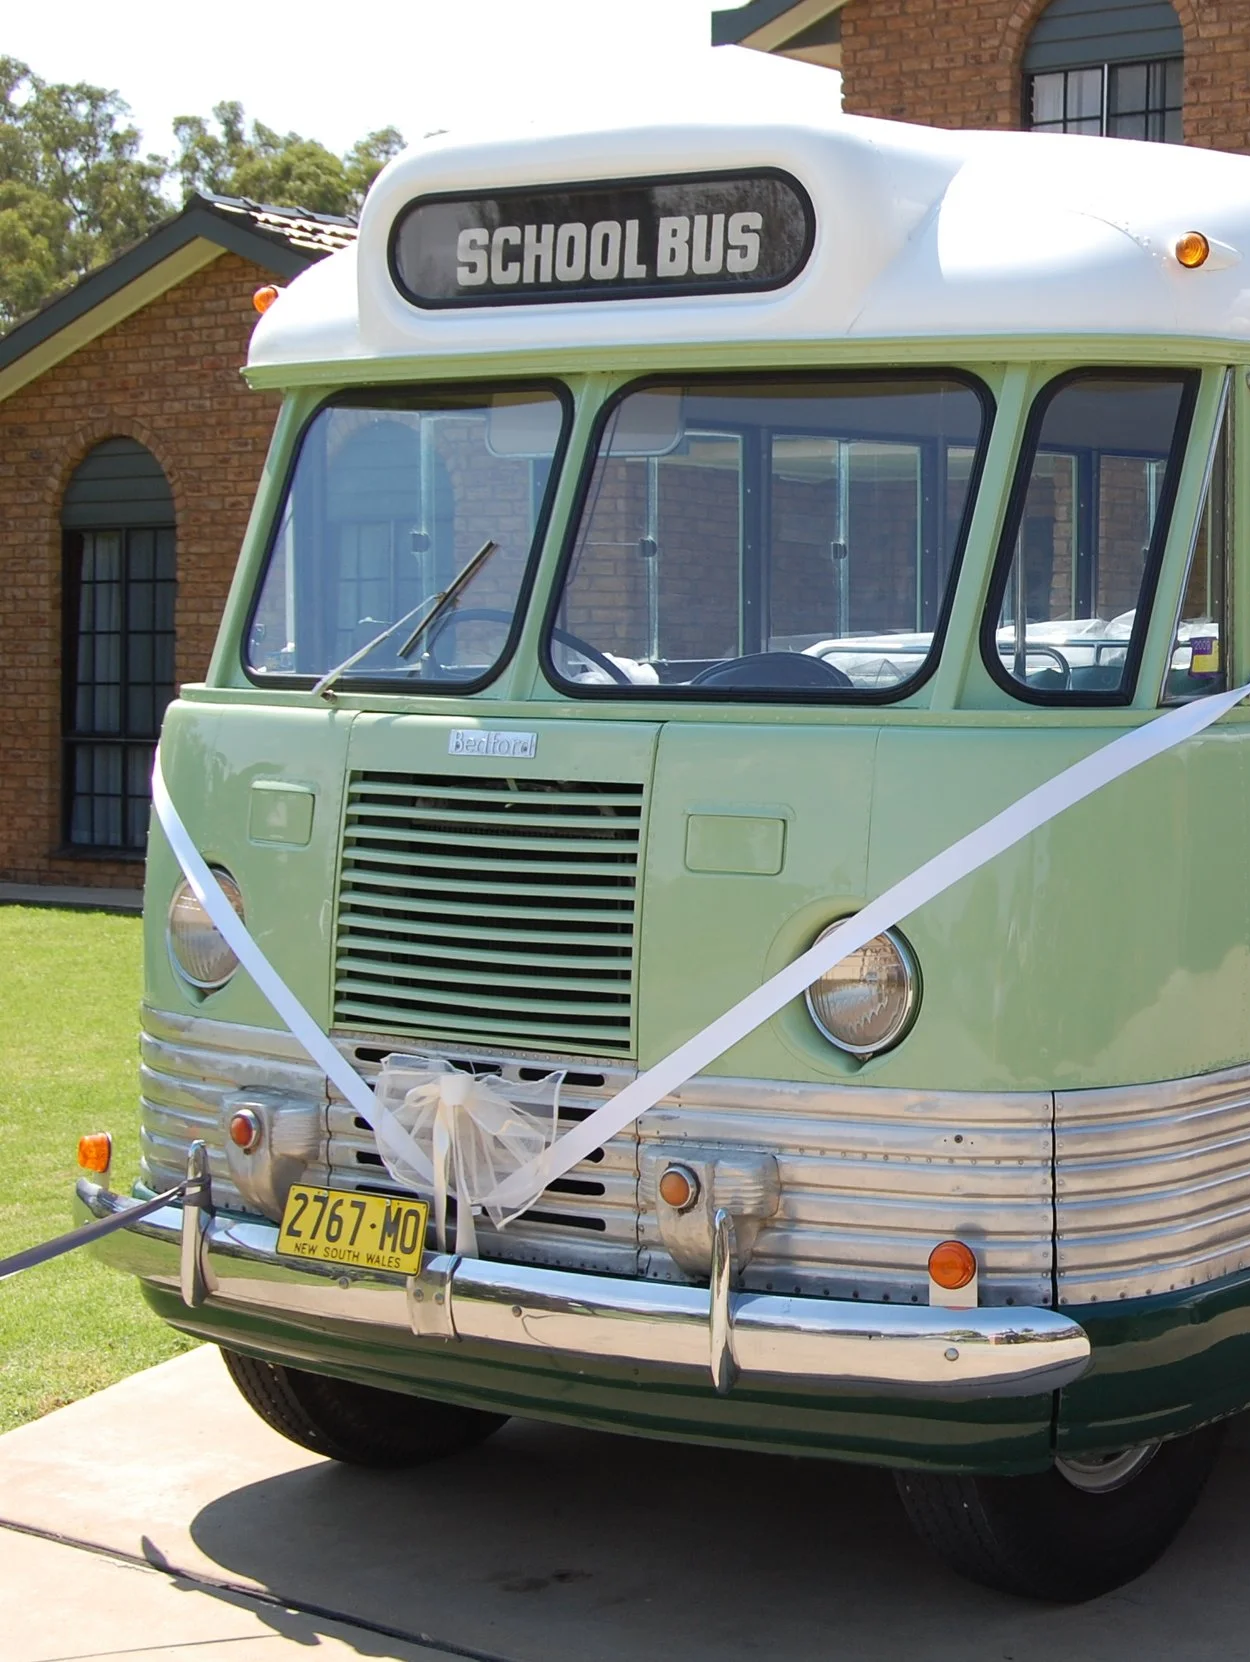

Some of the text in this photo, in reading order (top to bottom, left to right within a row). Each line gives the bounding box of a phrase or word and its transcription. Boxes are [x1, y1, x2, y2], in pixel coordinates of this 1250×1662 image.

[456, 212, 763, 286] SCHOOL BUS
[454, 731, 536, 756] Bedford
[294, 1242, 401, 1269] NEW SOUTH WALES
